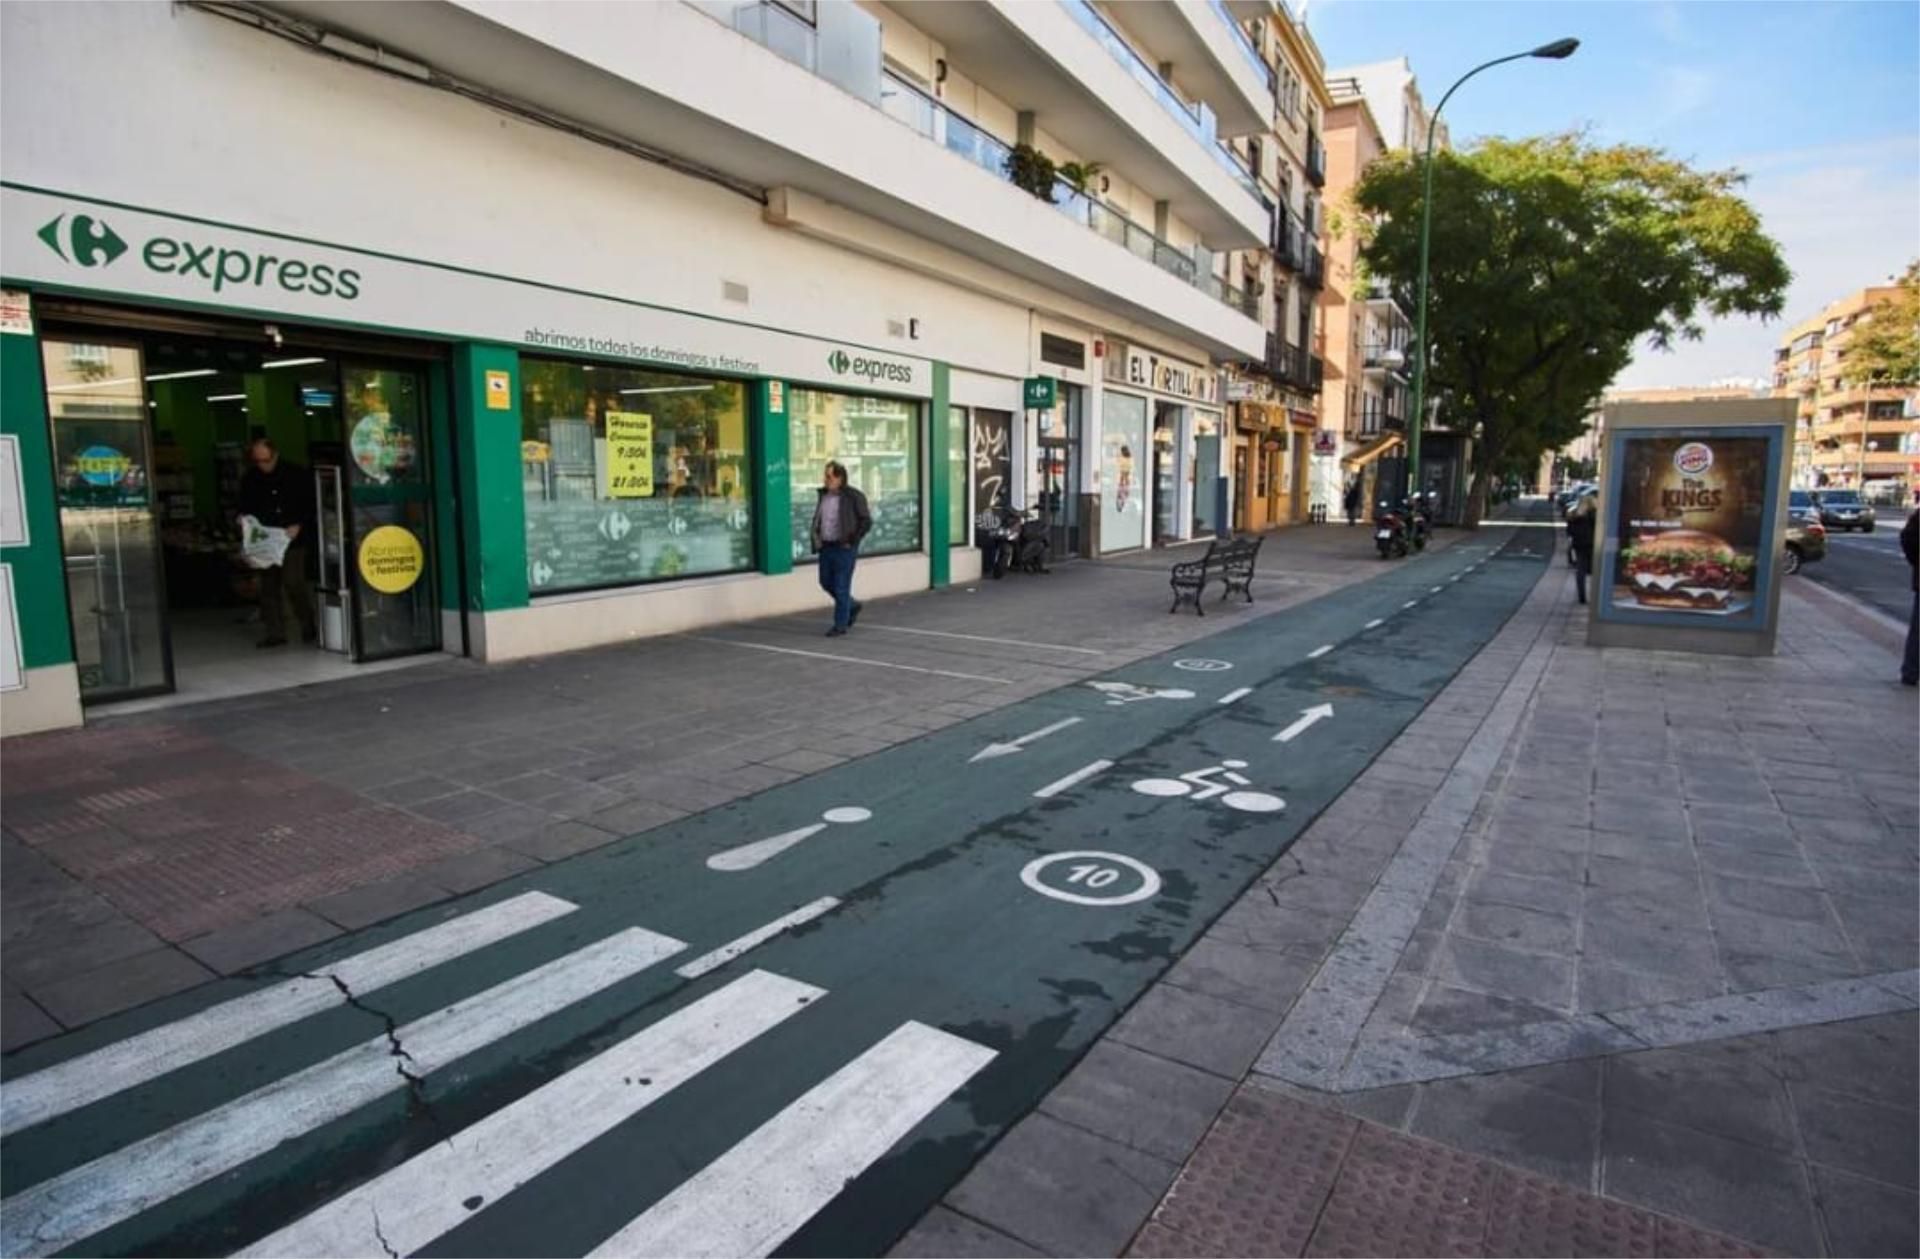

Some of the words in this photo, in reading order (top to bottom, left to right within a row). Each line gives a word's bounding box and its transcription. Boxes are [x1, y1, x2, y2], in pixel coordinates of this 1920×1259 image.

[142, 237, 361, 300] express
[524, 328, 586, 349] abrimos
[589, 338, 628, 355] todos
[631, 343, 648, 358] los
[650, 345, 708, 367] domingos
[711, 357, 718, 369] y
[719, 355, 759, 371] festivos
[852, 357, 912, 384] express
[1131, 356, 1145, 383] EL
[1682, 478, 1705, 490] The
[1661, 489, 1722, 507] KINGS
[1066, 864, 1119, 888] 10
